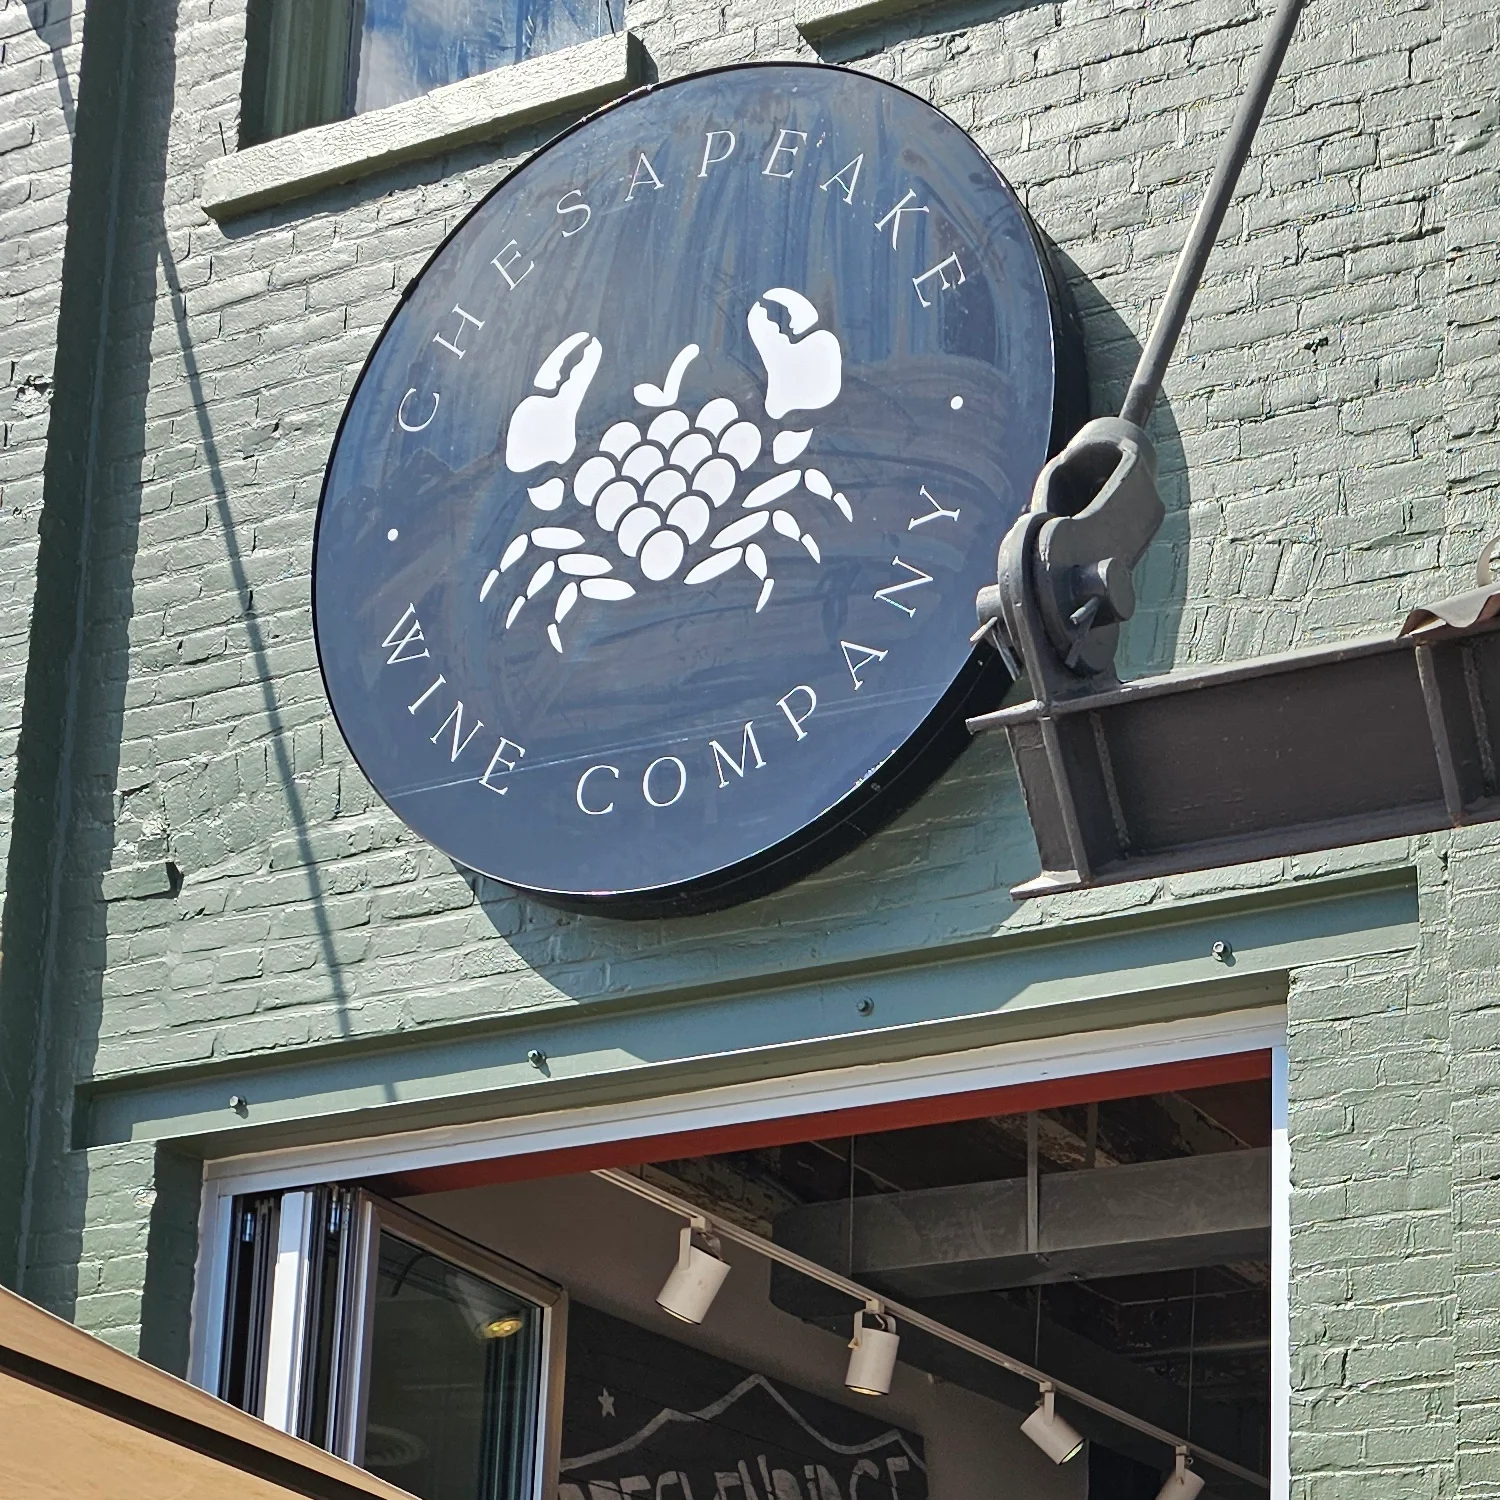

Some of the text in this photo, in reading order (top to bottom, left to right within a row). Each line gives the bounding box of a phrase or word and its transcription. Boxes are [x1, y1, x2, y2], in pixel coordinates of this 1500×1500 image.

[397, 127, 970, 435] CHESAPEAKE
[380, 485, 962, 816] WINE COMPANY
